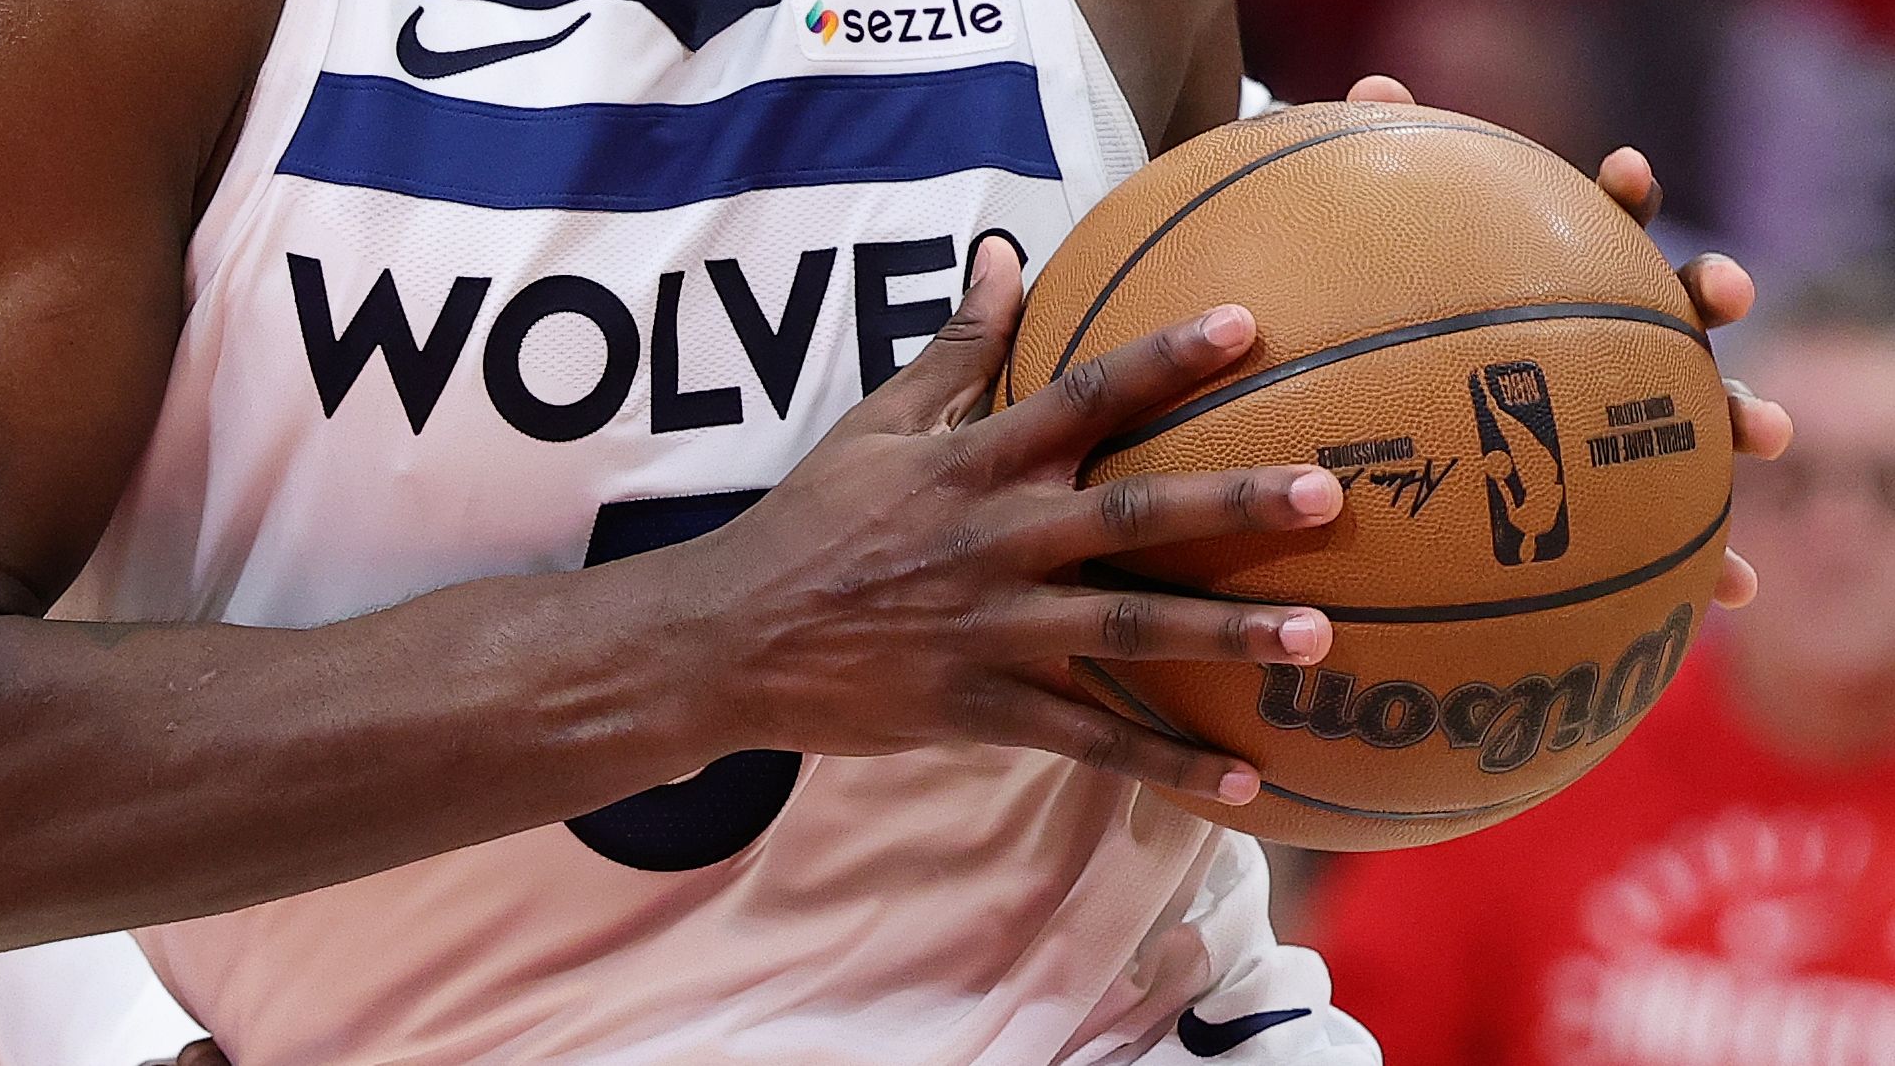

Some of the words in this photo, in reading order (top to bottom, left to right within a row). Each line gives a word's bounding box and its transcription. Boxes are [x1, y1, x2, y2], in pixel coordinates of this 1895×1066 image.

[1497, 369, 1541, 406] NBA
[1586, 436, 1621, 468] BALL
[1623, 429, 1655, 462] GAME
[1258, 602, 1693, 773] Wilson
